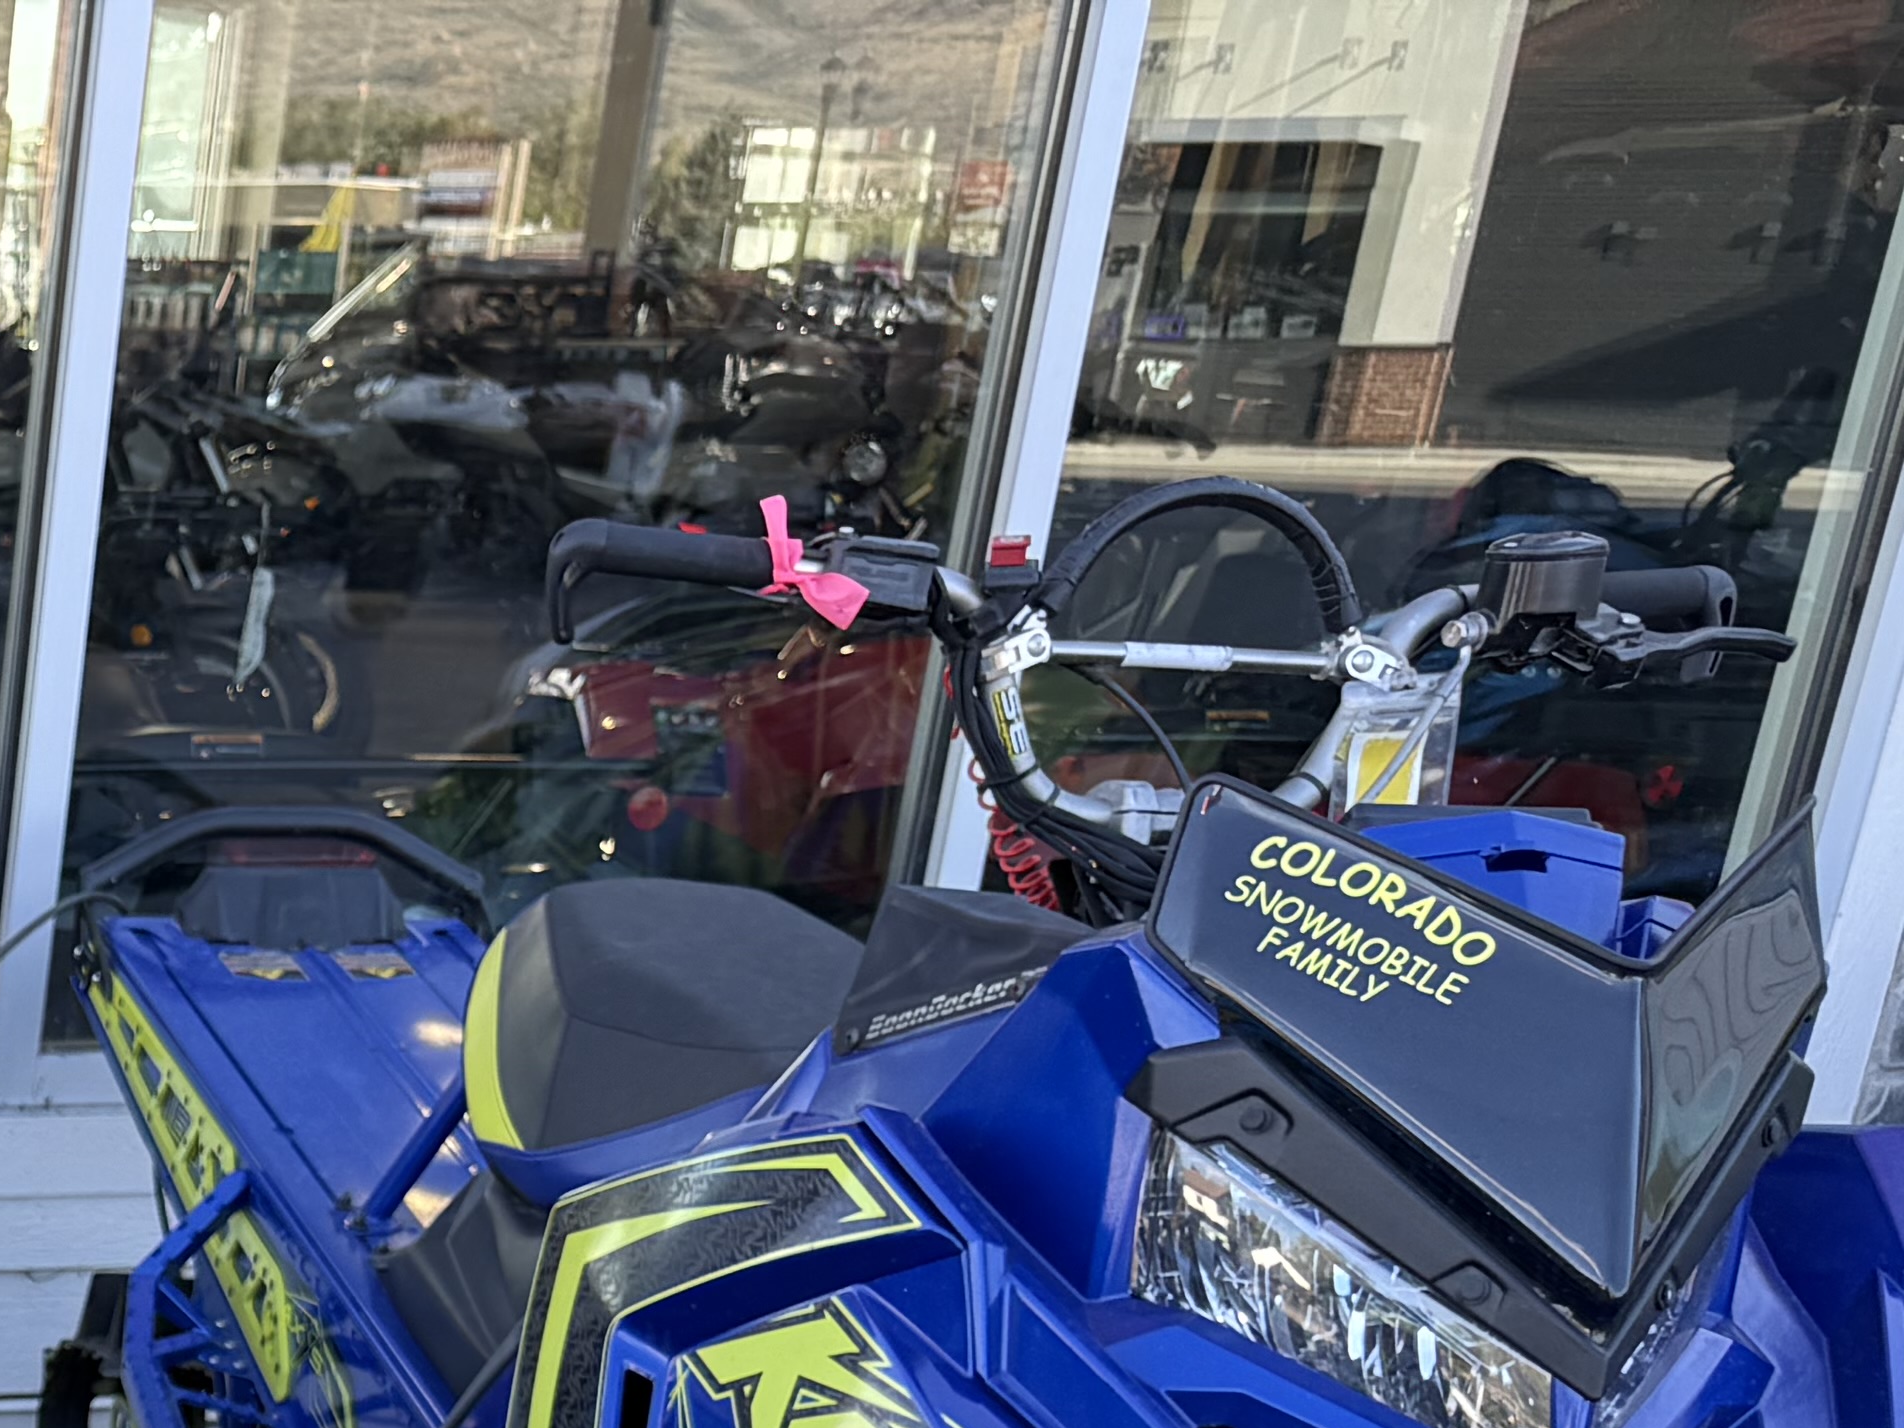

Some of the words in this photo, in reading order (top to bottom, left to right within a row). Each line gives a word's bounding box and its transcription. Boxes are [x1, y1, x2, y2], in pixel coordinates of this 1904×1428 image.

[1224, 874, 1470, 1005] SNOWMOBILE
[1249, 834, 1496, 967] COLORADO
[1256, 925, 1390, 1003] FAMILY
